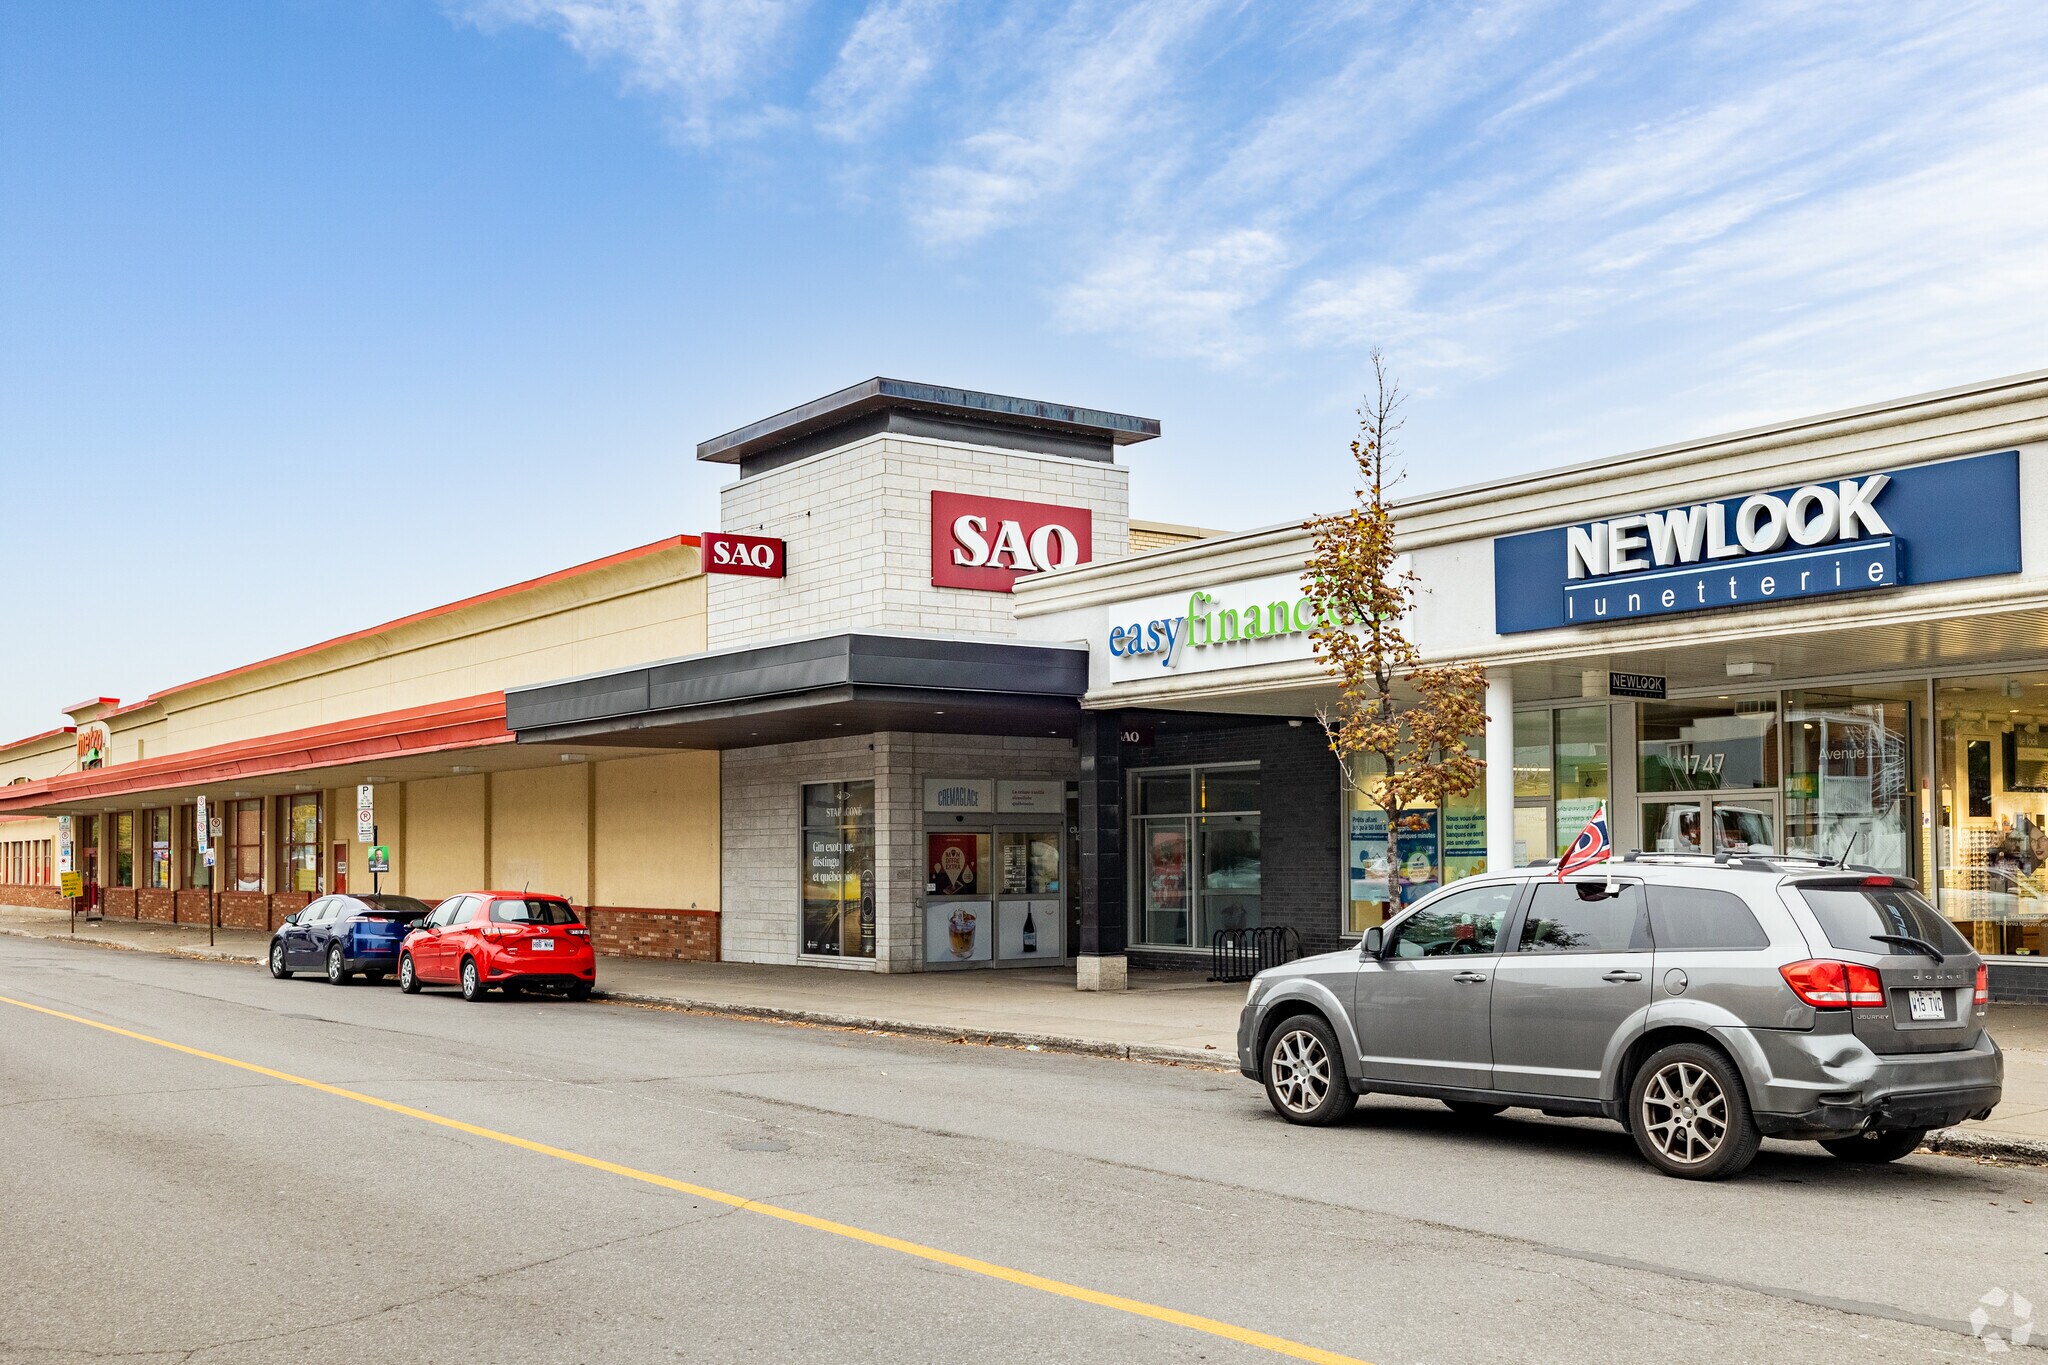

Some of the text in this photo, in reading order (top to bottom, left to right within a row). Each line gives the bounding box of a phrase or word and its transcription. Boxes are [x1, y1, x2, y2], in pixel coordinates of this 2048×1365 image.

[1567, 474, 1893, 579] NEWLOOK
[953, 514, 1079, 572] SAQ
[713, 541, 774, 569] SAQ
[1568, 559, 1884, 620] lunetterie
[1109, 576, 1388, 667] easyfinanciè
[1612, 674, 1662, 690] NEWLOOK
[78, 726, 103, 757] metro
[1818, 748, 1865, 760] Avenue
[1682, 753, 1725, 775] 1747
[362, 786, 369, 795] P
[938, 787, 979, 807] CREMAGLACE
[826, 804, 863, 817] STACONÉ
[812, 841, 855, 854] Gin exotque,
[812, 856, 840, 869] distingu
[812, 870, 853, 884] et québéis
[1928, 997, 1943, 1012] TVC
